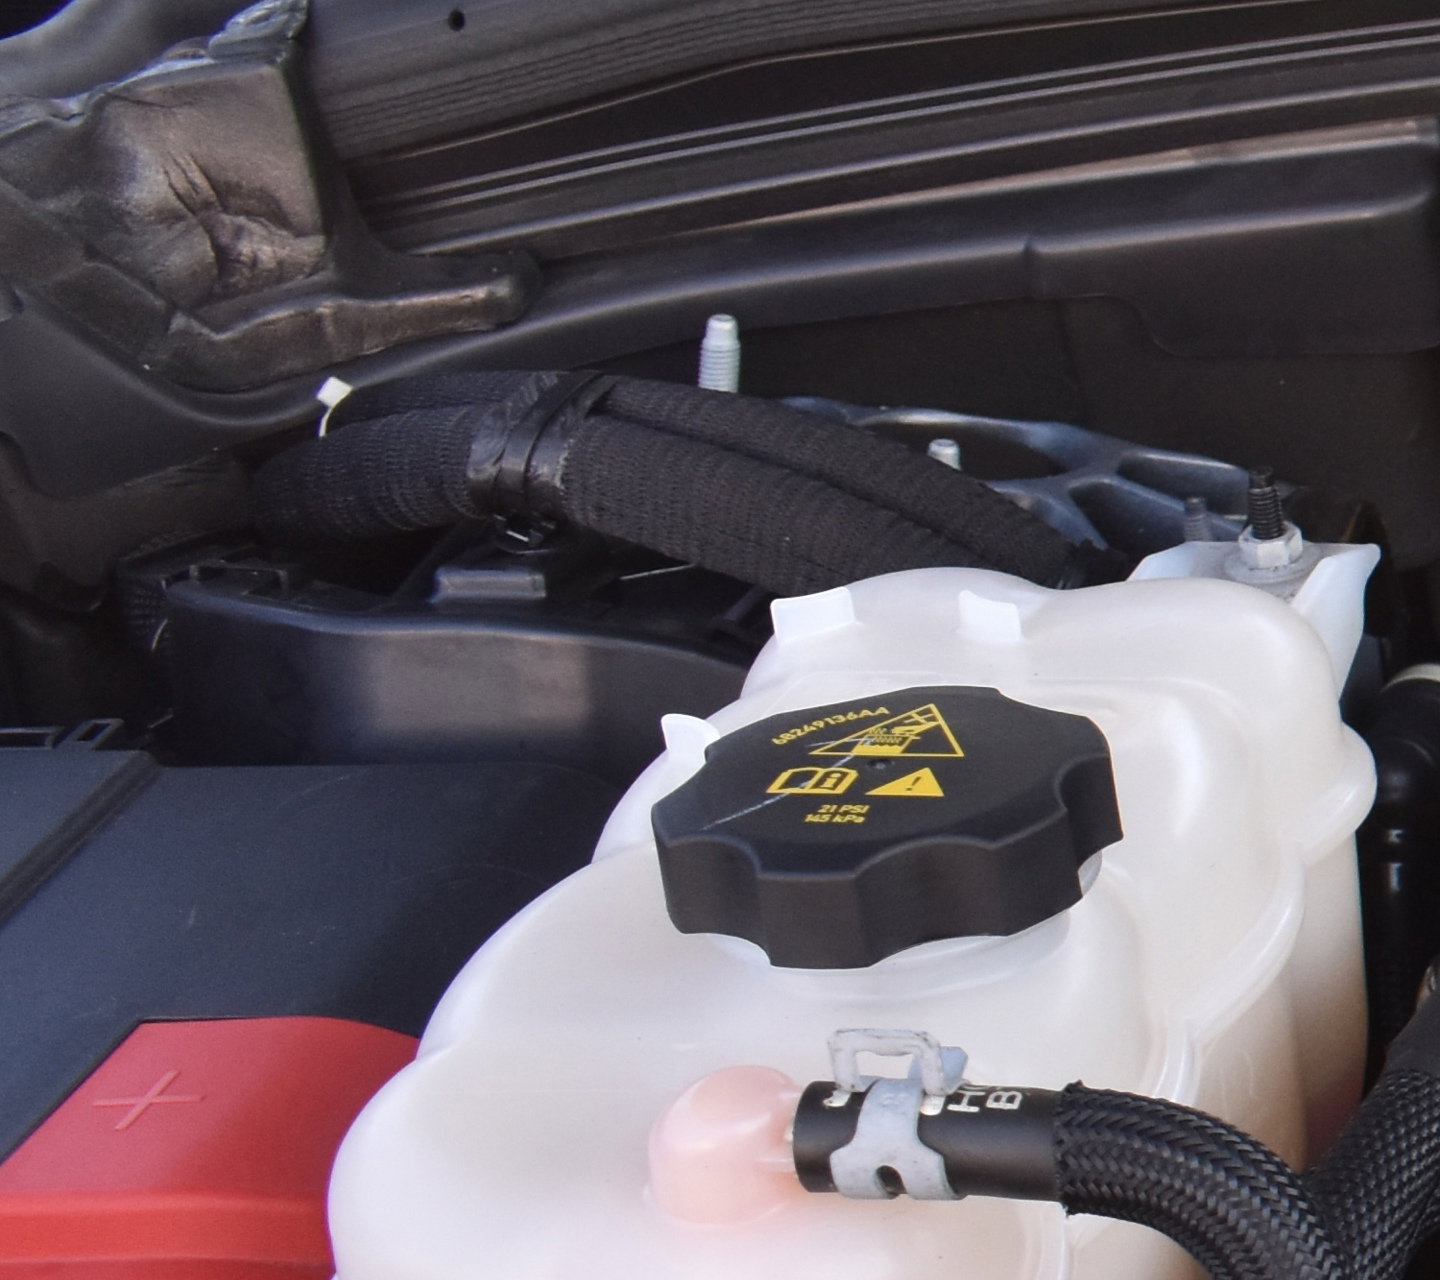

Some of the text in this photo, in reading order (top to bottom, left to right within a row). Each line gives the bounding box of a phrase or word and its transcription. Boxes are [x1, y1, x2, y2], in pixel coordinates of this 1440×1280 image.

[771, 706, 890, 745] 68249136AA
[817, 804, 871, 813] 21 PSI
[804, 814, 866, 823] 145 kPa
